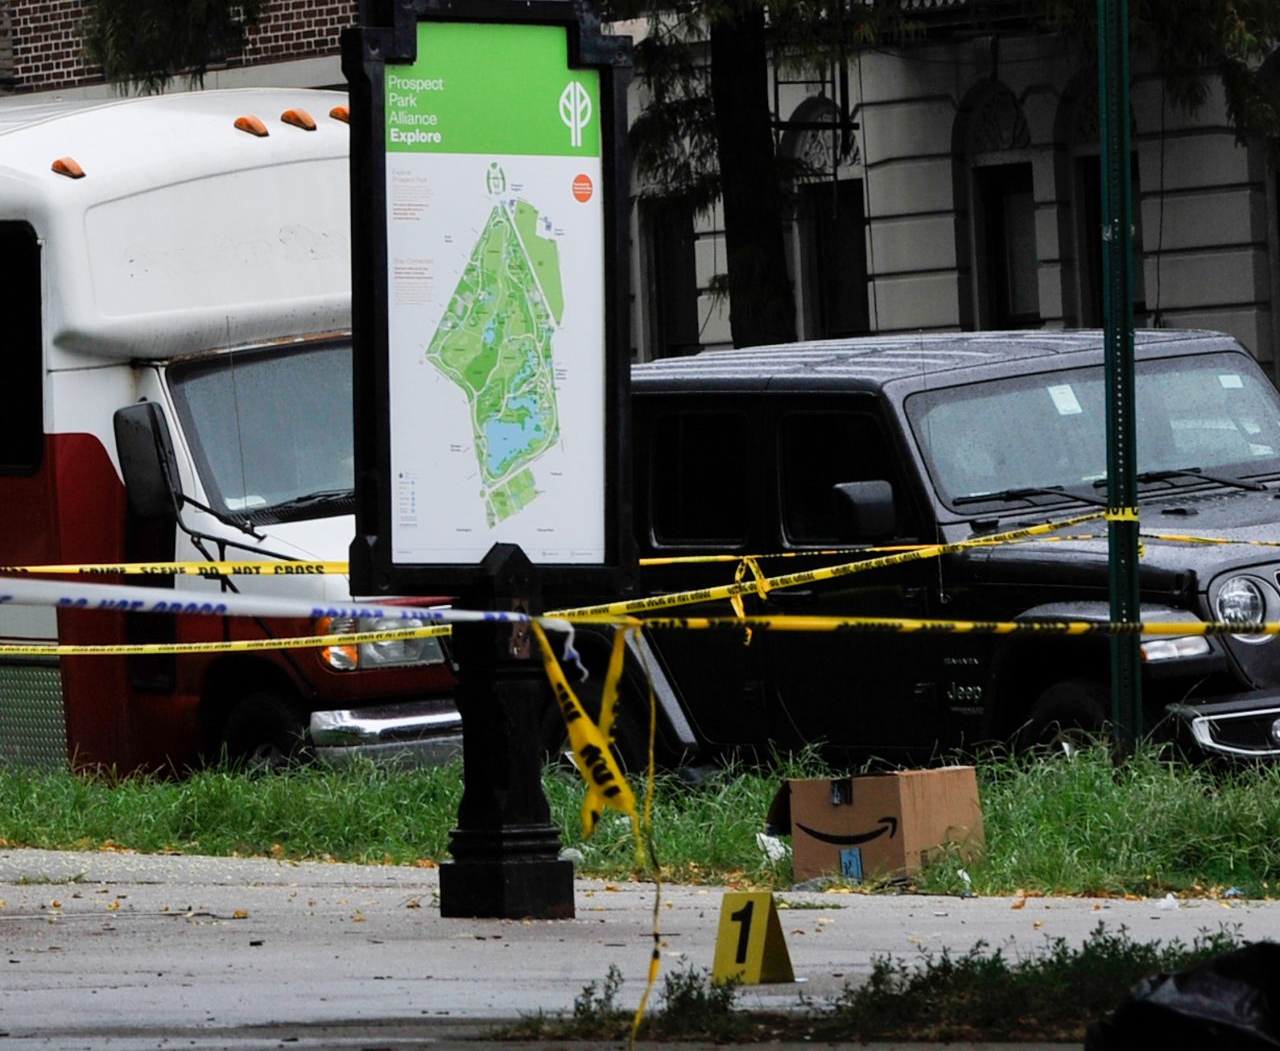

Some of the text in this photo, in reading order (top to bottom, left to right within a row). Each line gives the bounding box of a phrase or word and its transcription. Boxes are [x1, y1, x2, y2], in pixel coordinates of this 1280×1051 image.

[388, 76, 444, 91] Prospect
[389, 93, 417, 107] Park
[388, 111, 437, 125] Alliance
[390, 128, 442, 145] Explore
[947, 682, 983, 704] Jeep
[730, 900, 754, 964] 1
